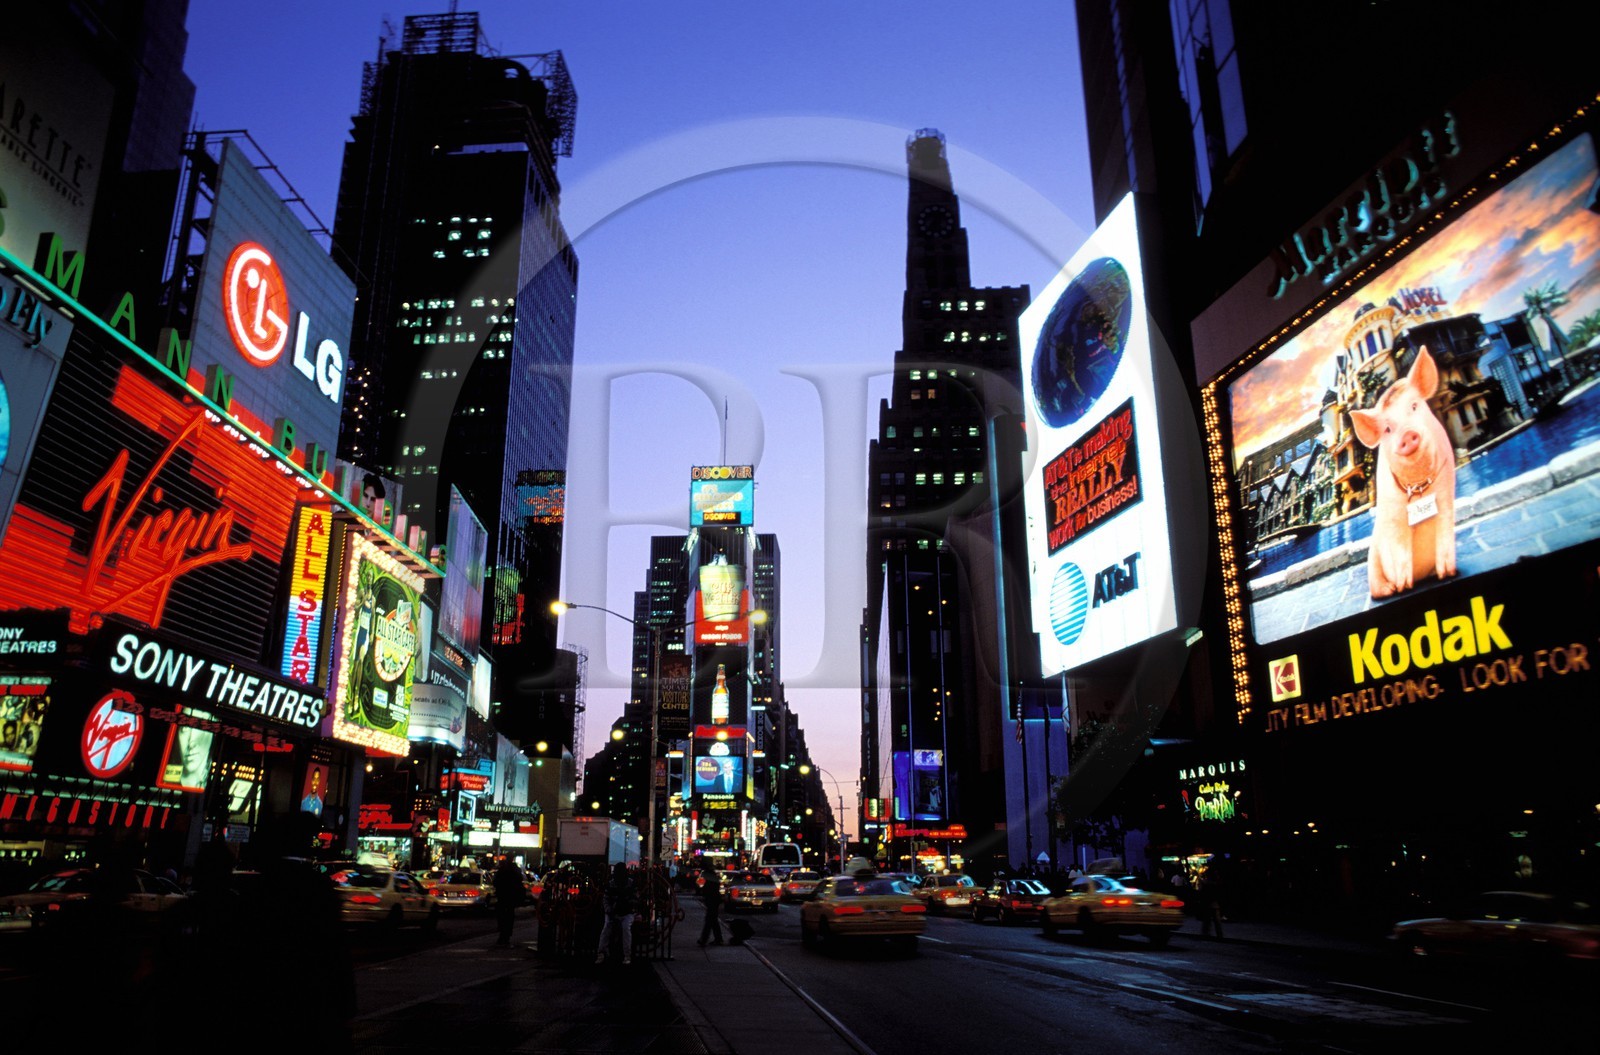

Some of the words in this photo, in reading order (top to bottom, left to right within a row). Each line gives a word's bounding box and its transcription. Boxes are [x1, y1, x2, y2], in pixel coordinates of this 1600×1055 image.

[293, 311, 343, 403] LG
[692, 466, 752, 479] DISCOVER
[1045, 448, 1074, 489] AT&T
[1084, 409, 1133, 459] making
[82, 407, 253, 630] Virgin
[703, 512, 736, 521] DISCOVER
[1049, 517, 1075, 550] work
[1076, 511, 1087, 532] for
[1087, 475, 1138, 524] business!
[1051, 480, 1068, 500] the
[1054, 453, 1126, 525] REALLY
[303, 513, 325, 582] ALL
[1092, 552, 1141, 609] AT&T
[290, 589, 318, 685] STAR
[1348, 596, 1513, 684] Kodak
[1460, 655, 1527, 693] LOOK
[1534, 643, 1591, 679] FOR
[110, 634, 205, 693] SONY
[200, 664, 324, 729] THEATRES
[88, 708, 137, 770] Virgin
[1180, 760, 1245, 780] MARQUIS
